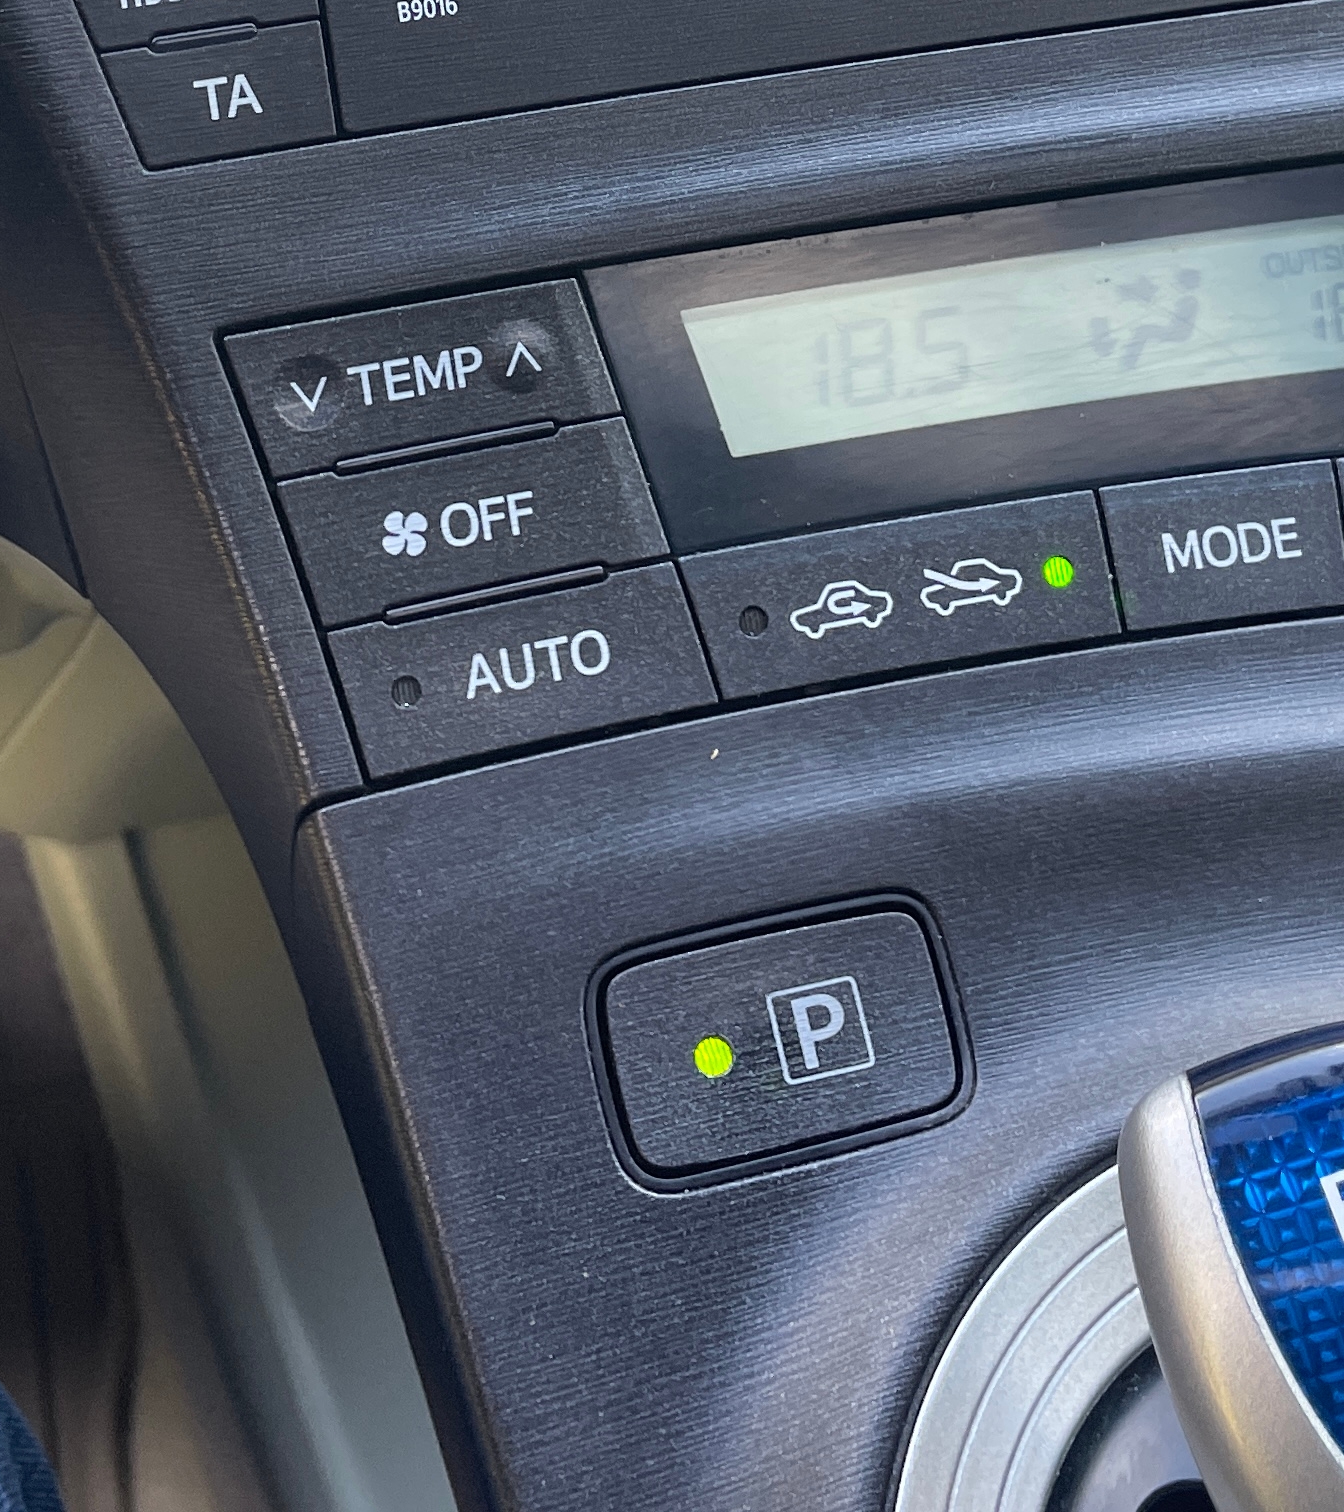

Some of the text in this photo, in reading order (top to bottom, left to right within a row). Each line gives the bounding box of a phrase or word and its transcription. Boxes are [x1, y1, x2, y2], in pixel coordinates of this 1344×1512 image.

[192, 73, 263, 121] TA
[346, 346, 483, 406] TEMP
[440, 490, 534, 547] OFF
[1161, 516, 1303, 574] MODE
[466, 629, 610, 700] AUTO
[788, 992, 847, 1072] P
